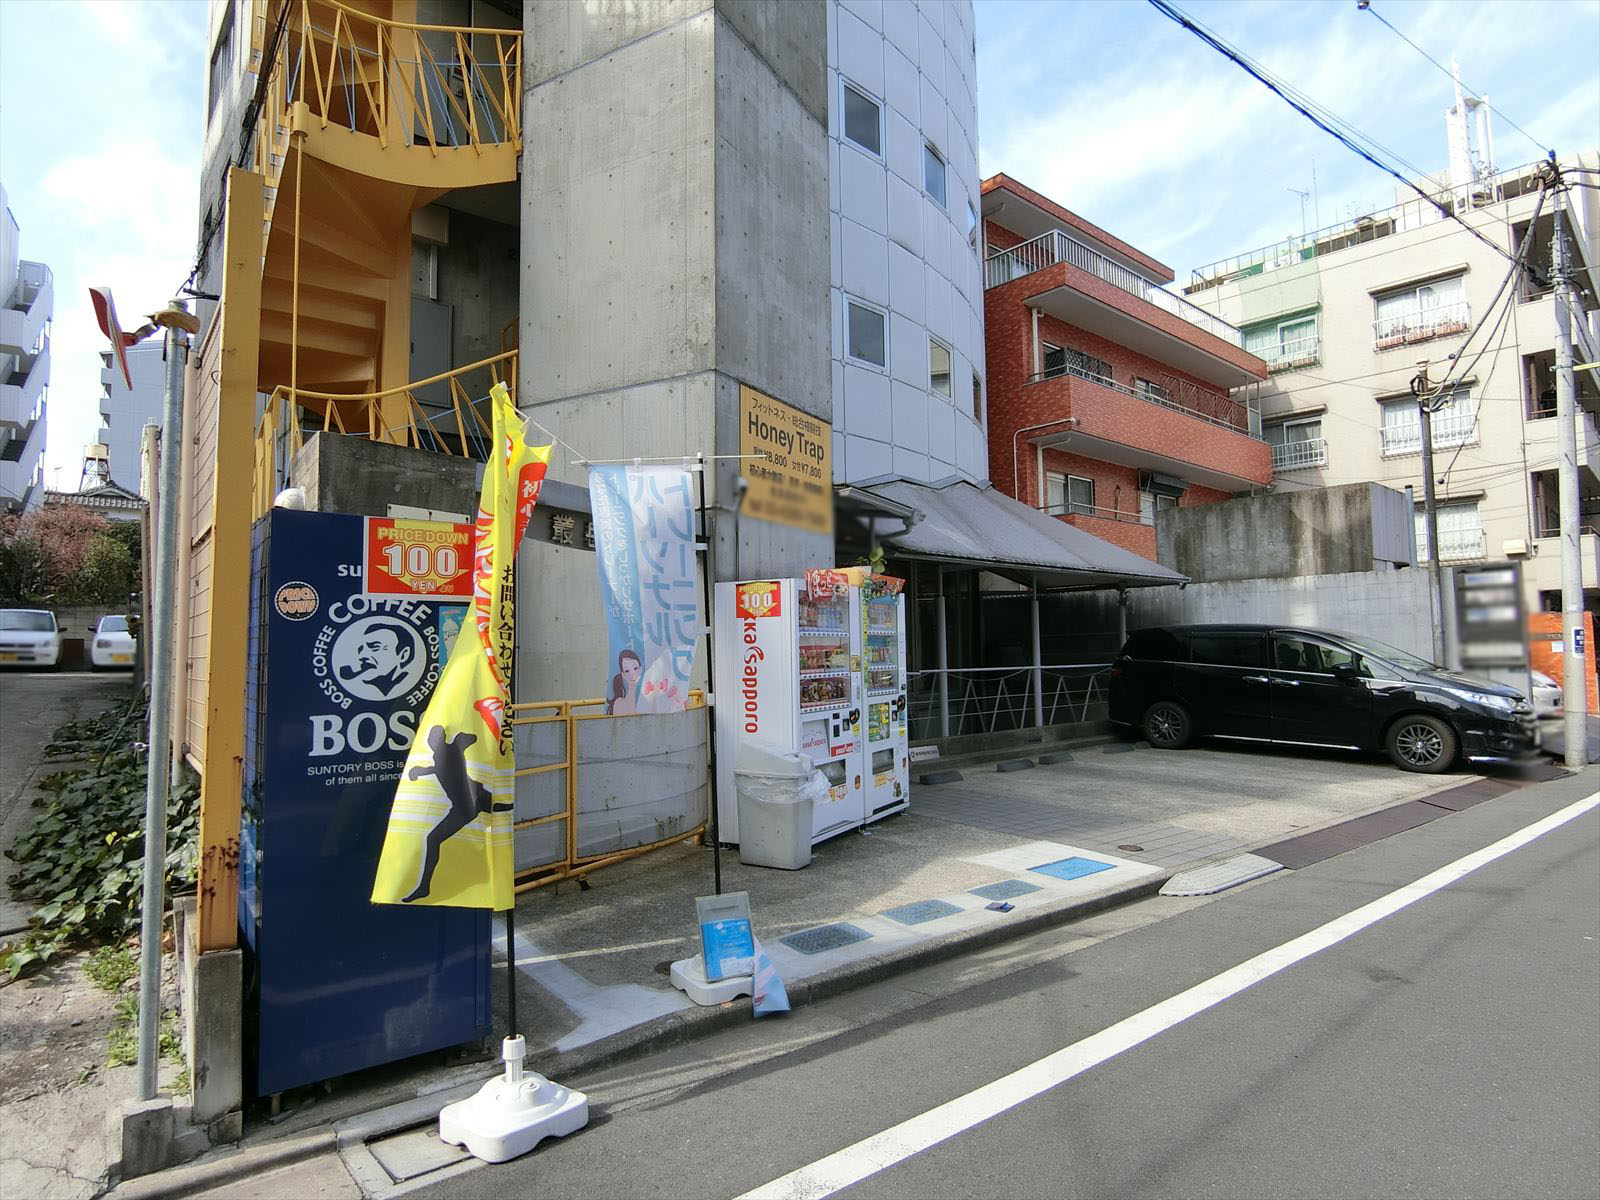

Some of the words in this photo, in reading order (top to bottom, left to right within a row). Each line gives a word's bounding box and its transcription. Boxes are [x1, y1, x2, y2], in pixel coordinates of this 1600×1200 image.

[748, 411, 794, 455] Honey
[796, 431, 825, 465] Trap
[383, 542, 459, 578] 100
[411, 579, 437, 591] YEN
[741, 592, 773, 609] 100
[279, 600, 316, 614] DOWN
[328, 593, 433, 627] COFFEE
[312, 625, 337, 677] COFFEE
[423, 626, 440, 660] BOSS
[319, 678, 353, 710] BOSS
[405, 662, 440, 707] COFFEE
[308, 710, 425, 757] BOS
[307, 763, 362, 776] SUNTORY
[364, 760, 394, 771] BOSS
[396, 760, 405, 768] is
[325, 776, 336, 786] of
[338, 775, 362, 785] them
[365, 773, 377, 782] all
